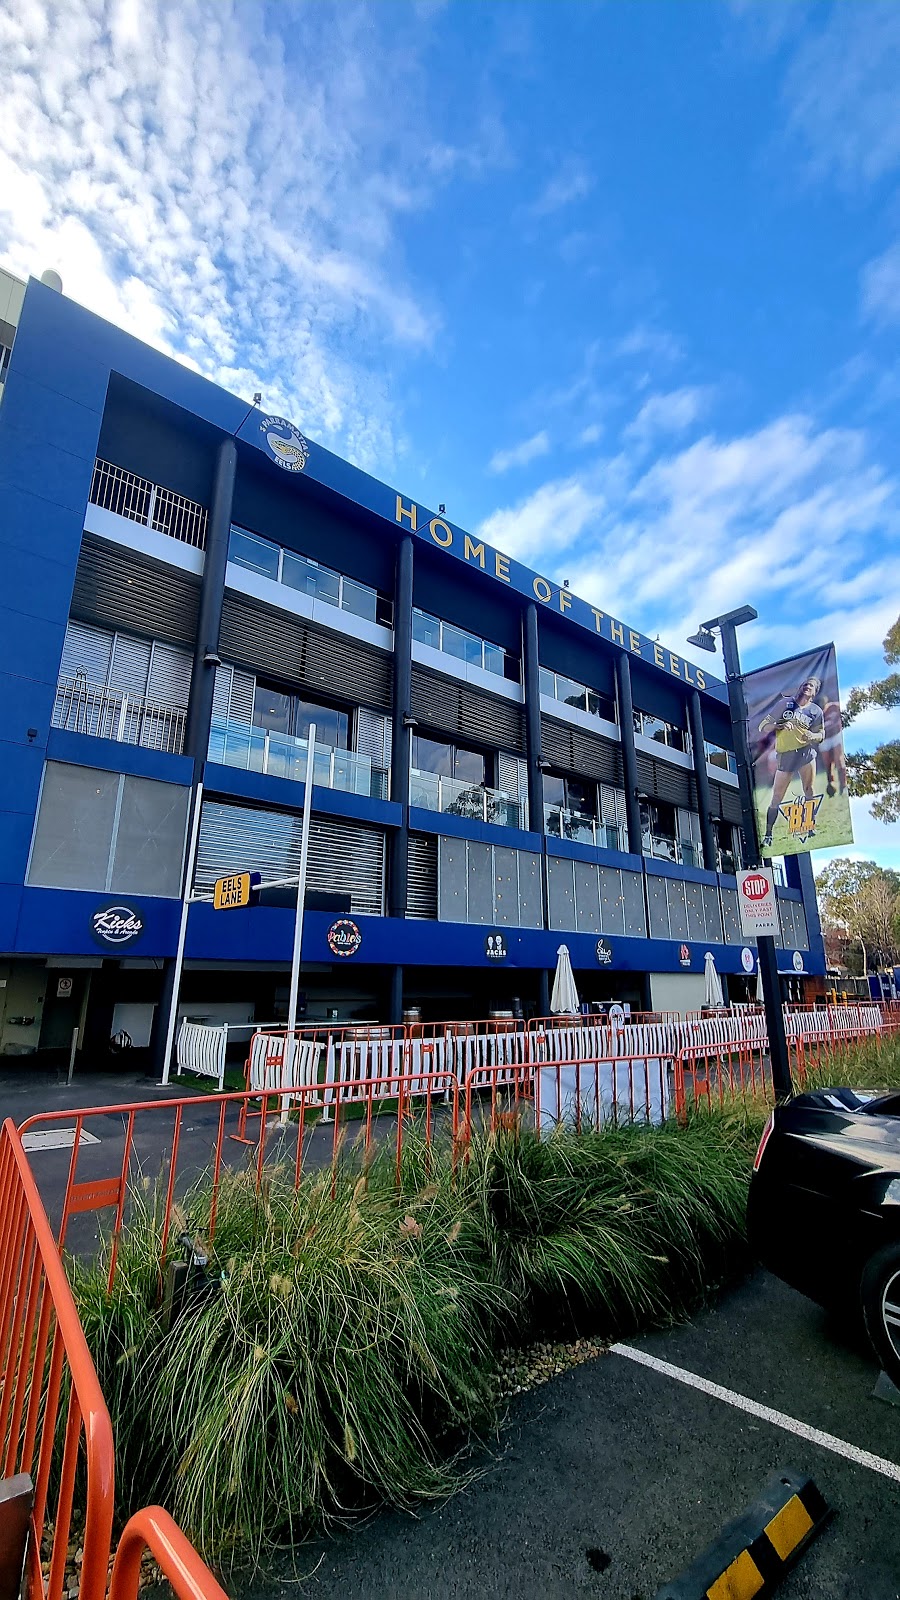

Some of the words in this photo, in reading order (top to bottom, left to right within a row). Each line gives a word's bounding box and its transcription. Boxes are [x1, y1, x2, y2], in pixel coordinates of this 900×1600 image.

[261, 417, 309, 451] PARRAMATTA
[274, 455, 292, 470] EELS
[395, 495, 511, 583] HOME
[532, 577, 572, 613] OF
[591, 608, 642, 655] THE
[653, 642, 706, 690] EELS
[222, 877, 242, 892] EELS
[745, 879, 766, 896] STOP
[220, 891, 242, 906] LANE
[94, 912, 142, 930] Kicks
